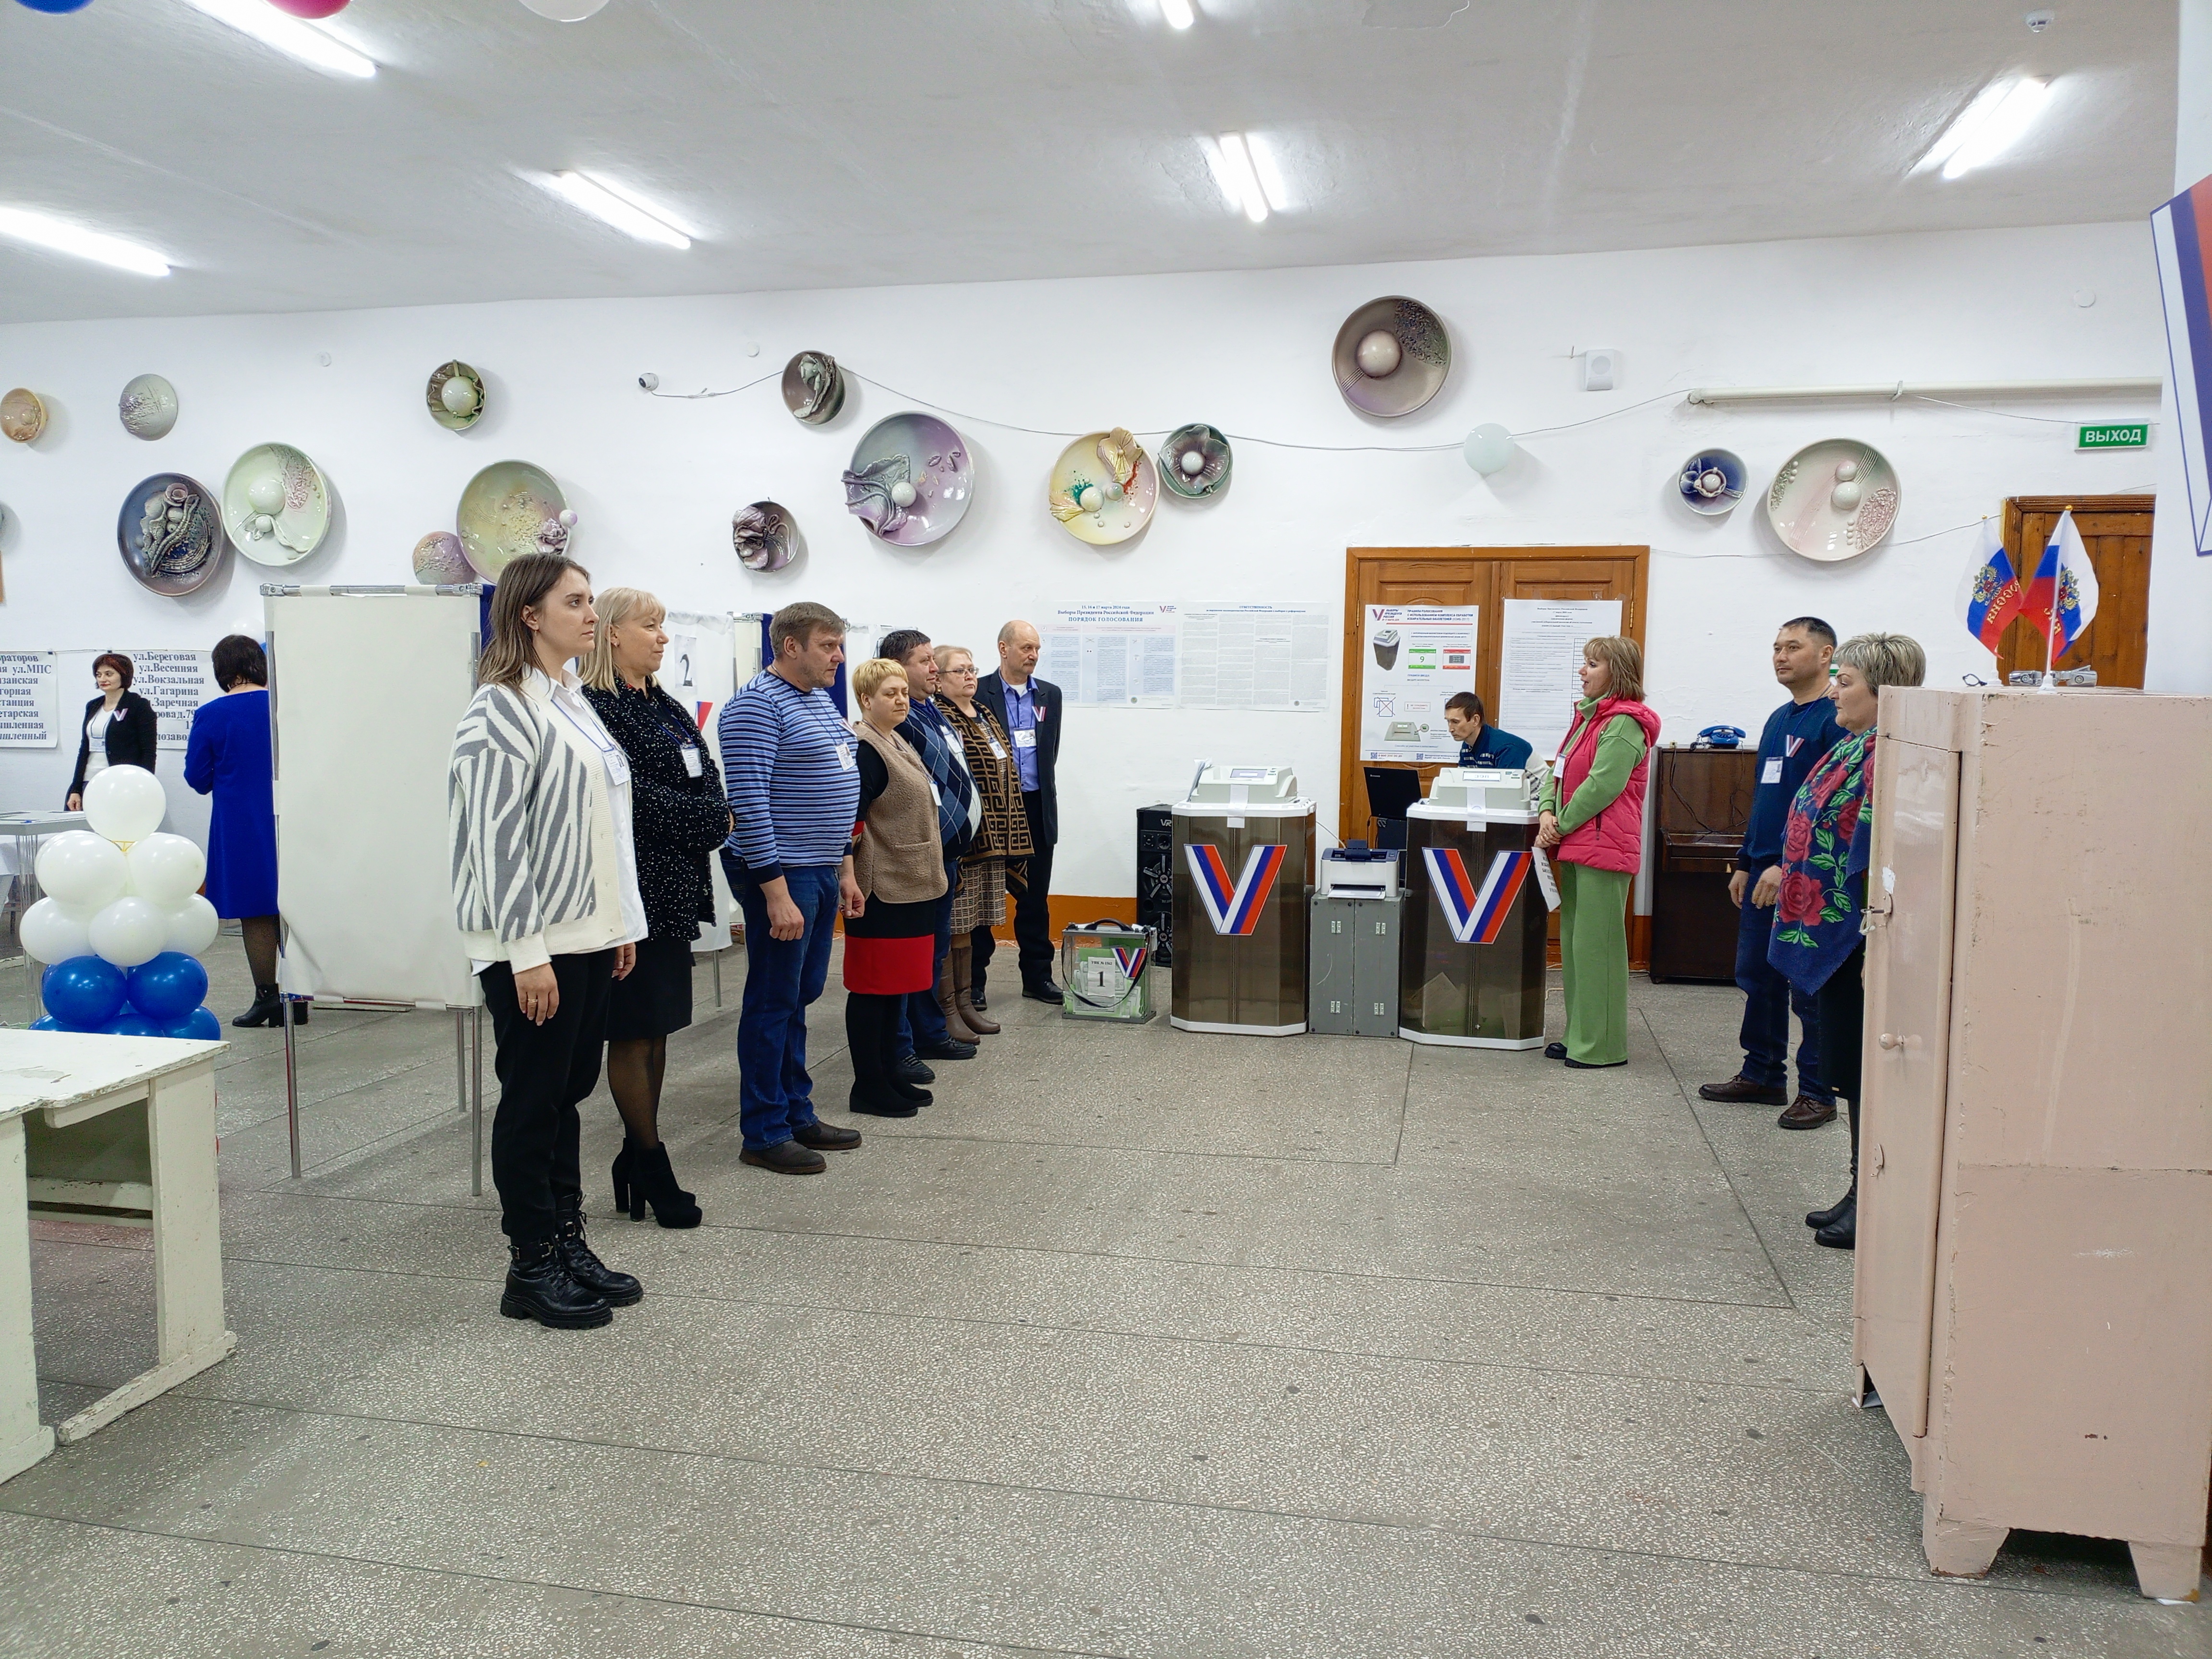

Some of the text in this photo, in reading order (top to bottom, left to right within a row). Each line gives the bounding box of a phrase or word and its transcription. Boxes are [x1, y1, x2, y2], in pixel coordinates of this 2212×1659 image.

[2085, 429, 2141, 443] ВЫХОД
[0, 655, 38, 664] раторов
[133, 651, 196, 663] ул.Береговая
[12, 664, 51, 675] ул.МПС
[139, 663, 198, 674] ул.Весенняя
[680, 654, 693, 686] 2
[133, 674, 204, 685] ул.Вокзальная
[139, 686, 199, 697] ул.Гагарина
[1097, 970, 1106, 987] 1
